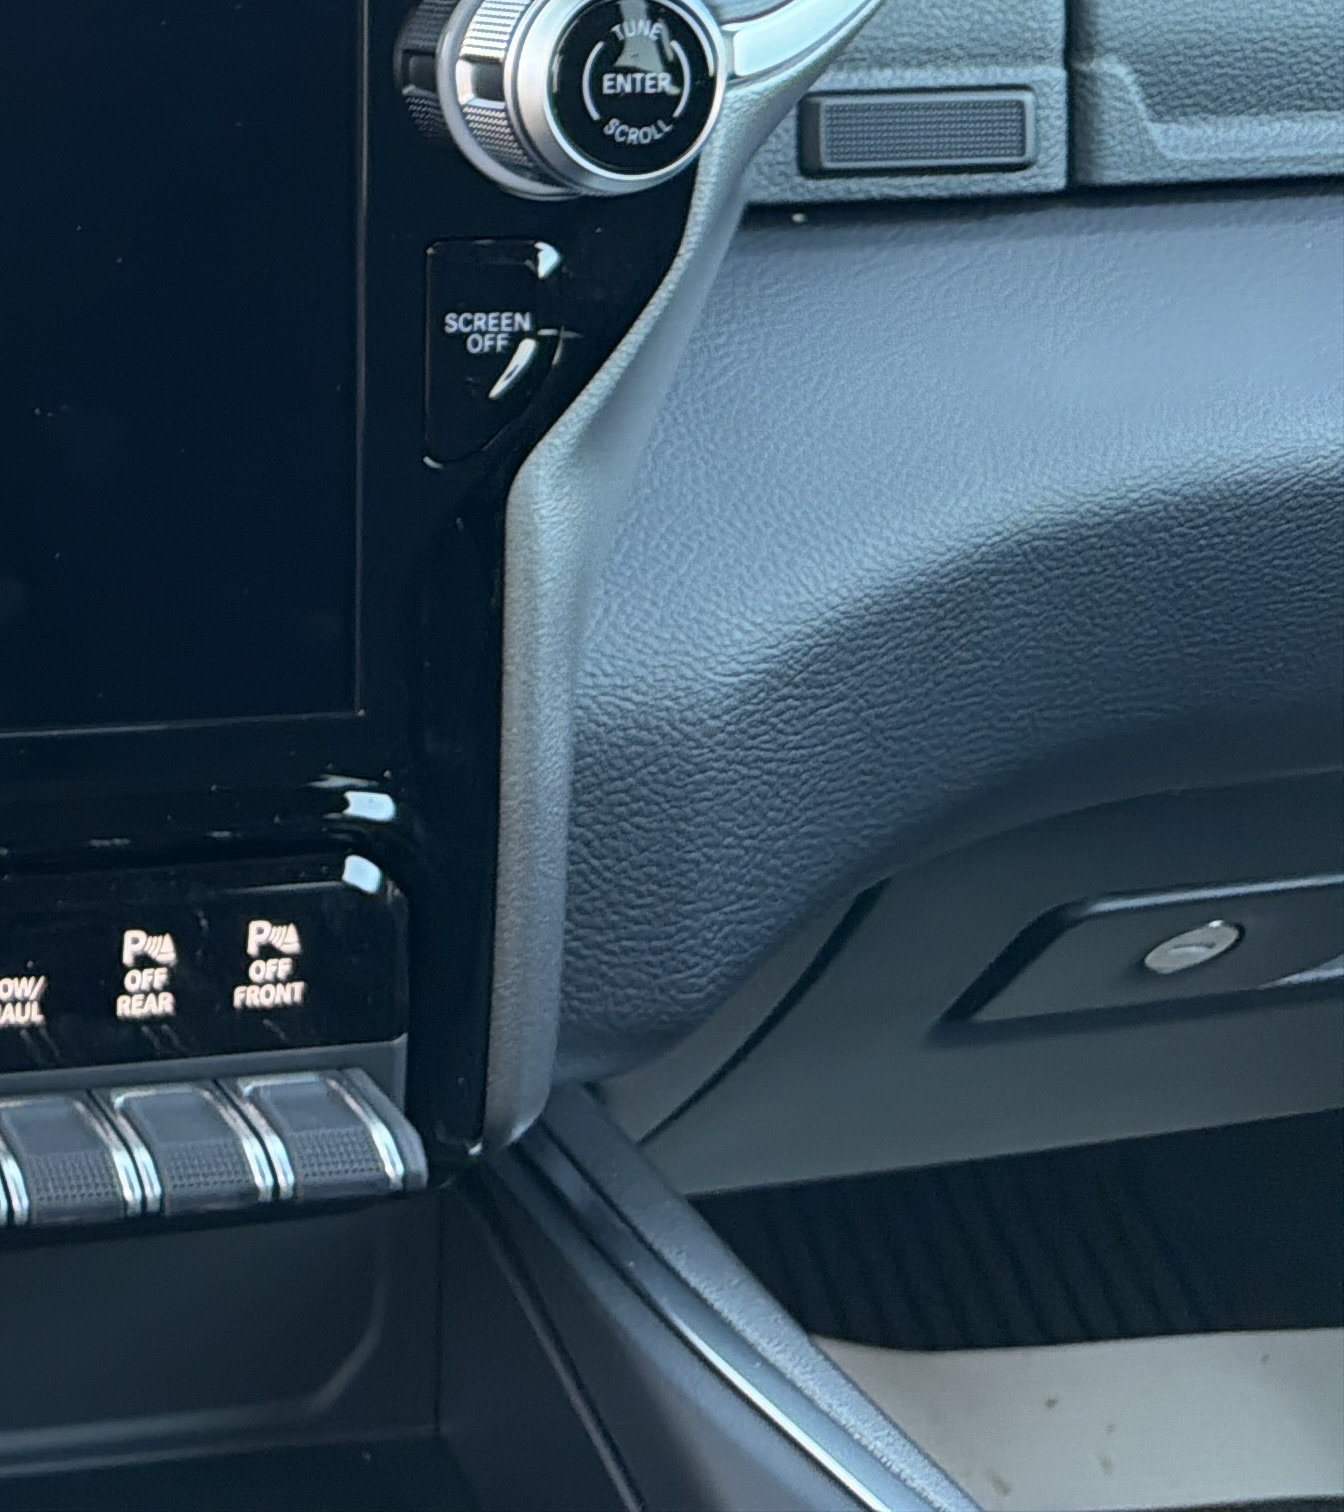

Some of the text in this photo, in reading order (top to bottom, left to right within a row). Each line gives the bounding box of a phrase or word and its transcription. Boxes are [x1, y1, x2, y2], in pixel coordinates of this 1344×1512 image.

[610, 19, 663, 41] TUNE
[602, 73, 673, 95] ENTER
[602, 118, 675, 145] SCROLL
[444, 312, 533, 333] SCREEN
[466, 333, 510, 354] OFF
[123, 968, 170, 993] OFF
[247, 957, 293, 982] OFF
[116, 992, 175, 1019] REAR
[232, 981, 307, 1009] FRONT
